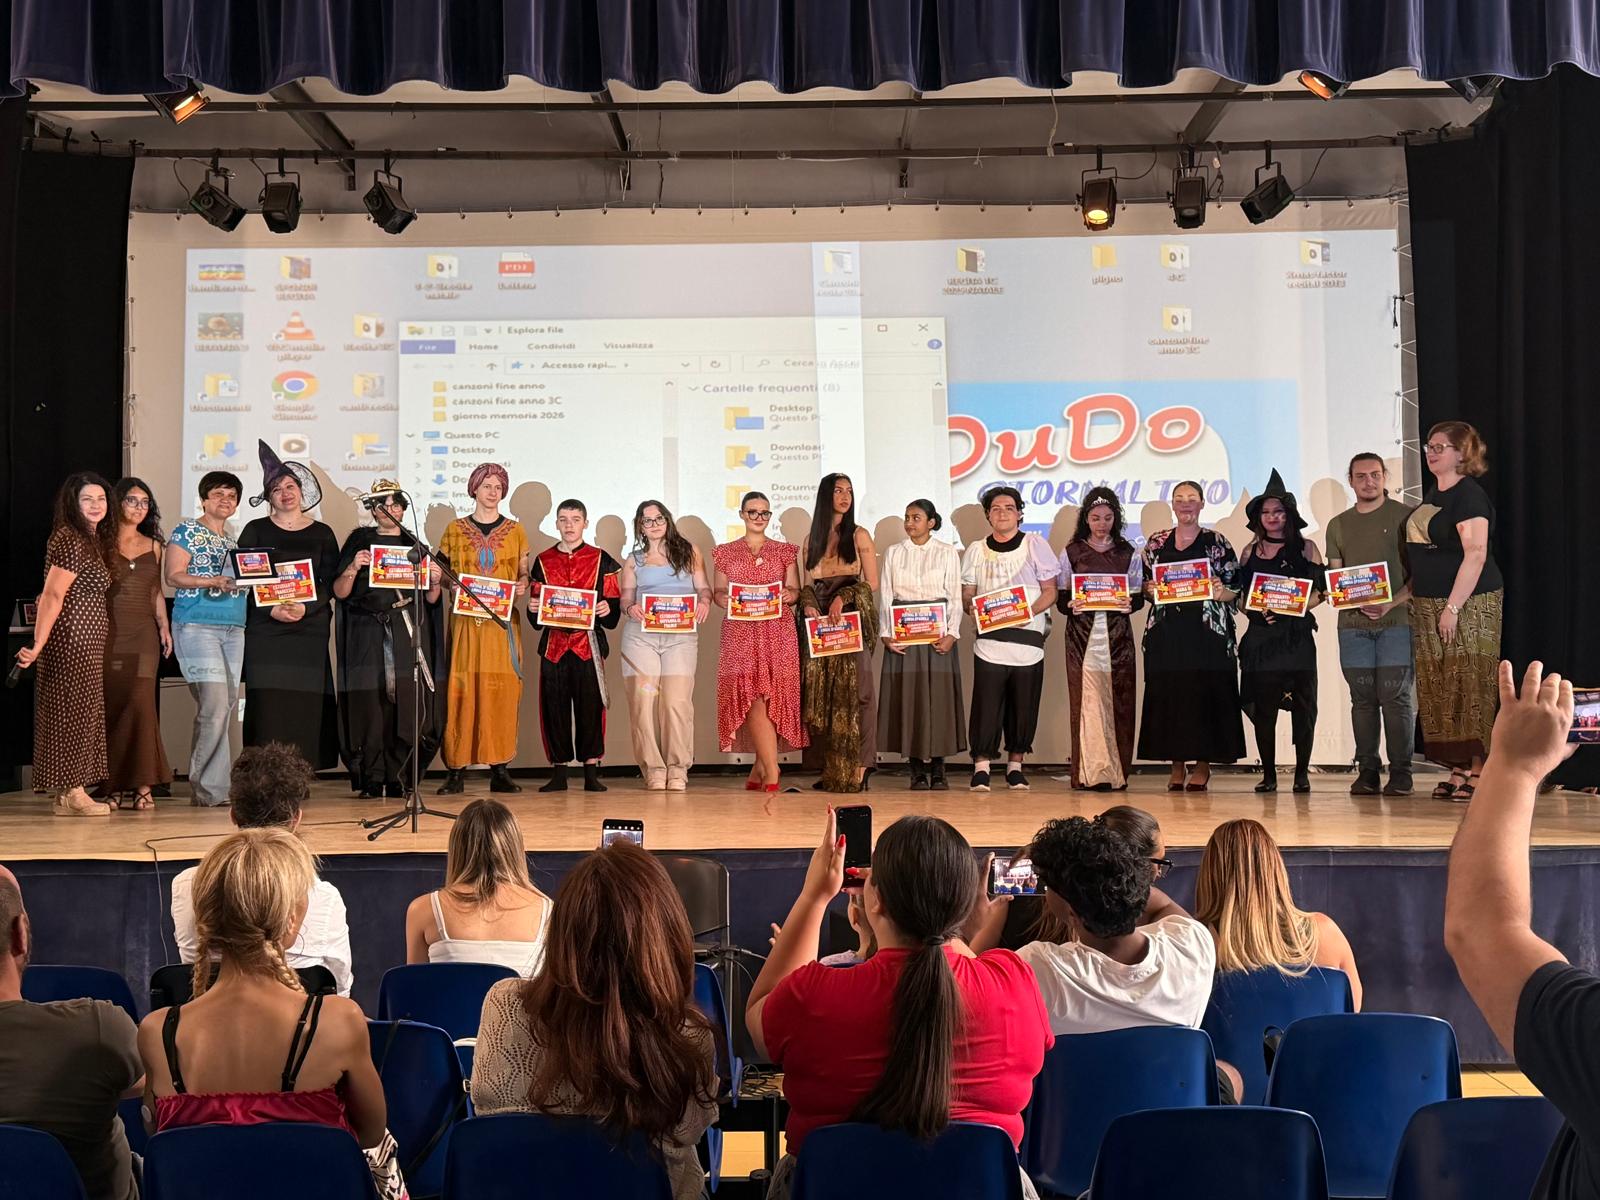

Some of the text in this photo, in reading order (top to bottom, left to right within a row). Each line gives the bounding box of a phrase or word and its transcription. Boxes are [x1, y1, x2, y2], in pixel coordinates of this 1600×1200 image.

[507, 325, 565, 335] Esplora file
[418, 343, 437, 352] File
[468, 342, 499, 351] Home
[527, 341, 577, 351] Condividi
[603, 341, 655, 350] Visualizza
[541, 360, 585, 370] Accesso
[783, 358, 814, 368] Cerca
[452, 381, 545, 391] canzoni fine anno
[702, 382, 755, 393] Cartelle
[758, 382, 818, 394] frequenti
[452, 396, 563, 405] canzoni fine anno 3C
[769, 403, 813, 414] Desktop
[452, 411, 565, 422] giorno memoria 2026
[769, 413, 807, 423] Questo
[444, 431, 501, 441] Questo PC
[452, 445, 496, 455] Desktop
[770, 453, 809, 463] Questo
[771, 493, 810, 503] Questo
